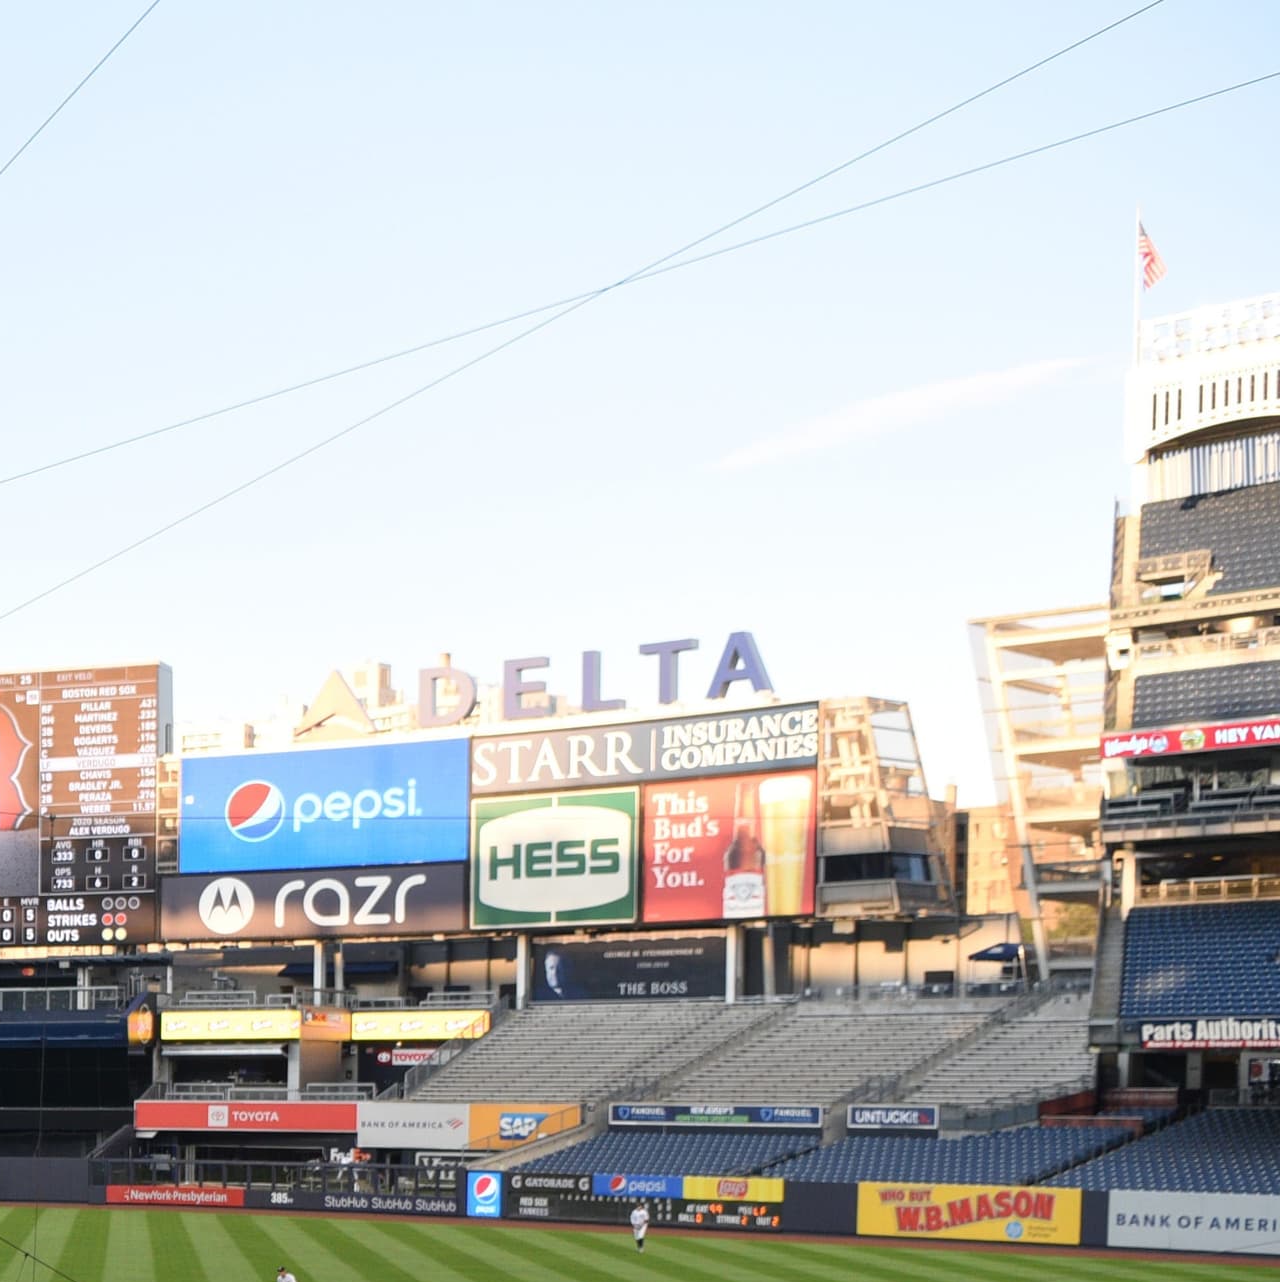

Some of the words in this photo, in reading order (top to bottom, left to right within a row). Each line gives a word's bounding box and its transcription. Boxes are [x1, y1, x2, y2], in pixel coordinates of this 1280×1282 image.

[418, 630, 774, 728] DELTA
[62, 686, 97, 699] BOSTON
[99, 686, 117, 696] RED
[119, 684, 137, 695] SOX
[660, 707, 818, 750] INSURANCE
[471, 729, 643, 788] STARR
[660, 733, 818, 772] COMPANIES
[293, 778, 418, 833] pepsi
[653, 791, 709, 816] This
[69, 826, 90, 836] ALEX
[91, 824, 131, 835] VERDUGO
[653, 814, 719, 839] Bud's
[488, 838, 620, 881] HESS
[653, 842, 695, 865] For
[653, 865, 704, 889] You.
[47, 898, 85, 911] BALLS
[274, 874, 427, 928] razr
[47, 913, 97, 927] STRIKES
[47, 929, 80, 942] OUTS
[618, 982, 647, 996] THE
[650, 980, 688, 995] BOSS
[1141, 1022, 1193, 1042] Parts
[232, 1111, 279, 1122] TOYOTA
[361, 1120, 386, 1129] BANK
[388, 1120, 399, 1129] OF
[400, 1120, 444, 1129] AMERICA
[500, 1117, 538, 1136] SAP
[525, 1177, 575, 1189] GATORADE
[628, 1179, 667, 1193] pepsi
[270, 1192, 288, 1204] 385
[324, 1195, 368, 1209] StubHub
[371, 1197, 412, 1210] StubHub
[879, 1190, 906, 1202] WHO
[908, 1190, 932, 1202] BUT
[416, 1198, 456, 1212] StubHub
[1116, 1213, 1172, 1229] BANK
[1177, 1215, 1204, 1230] OF
